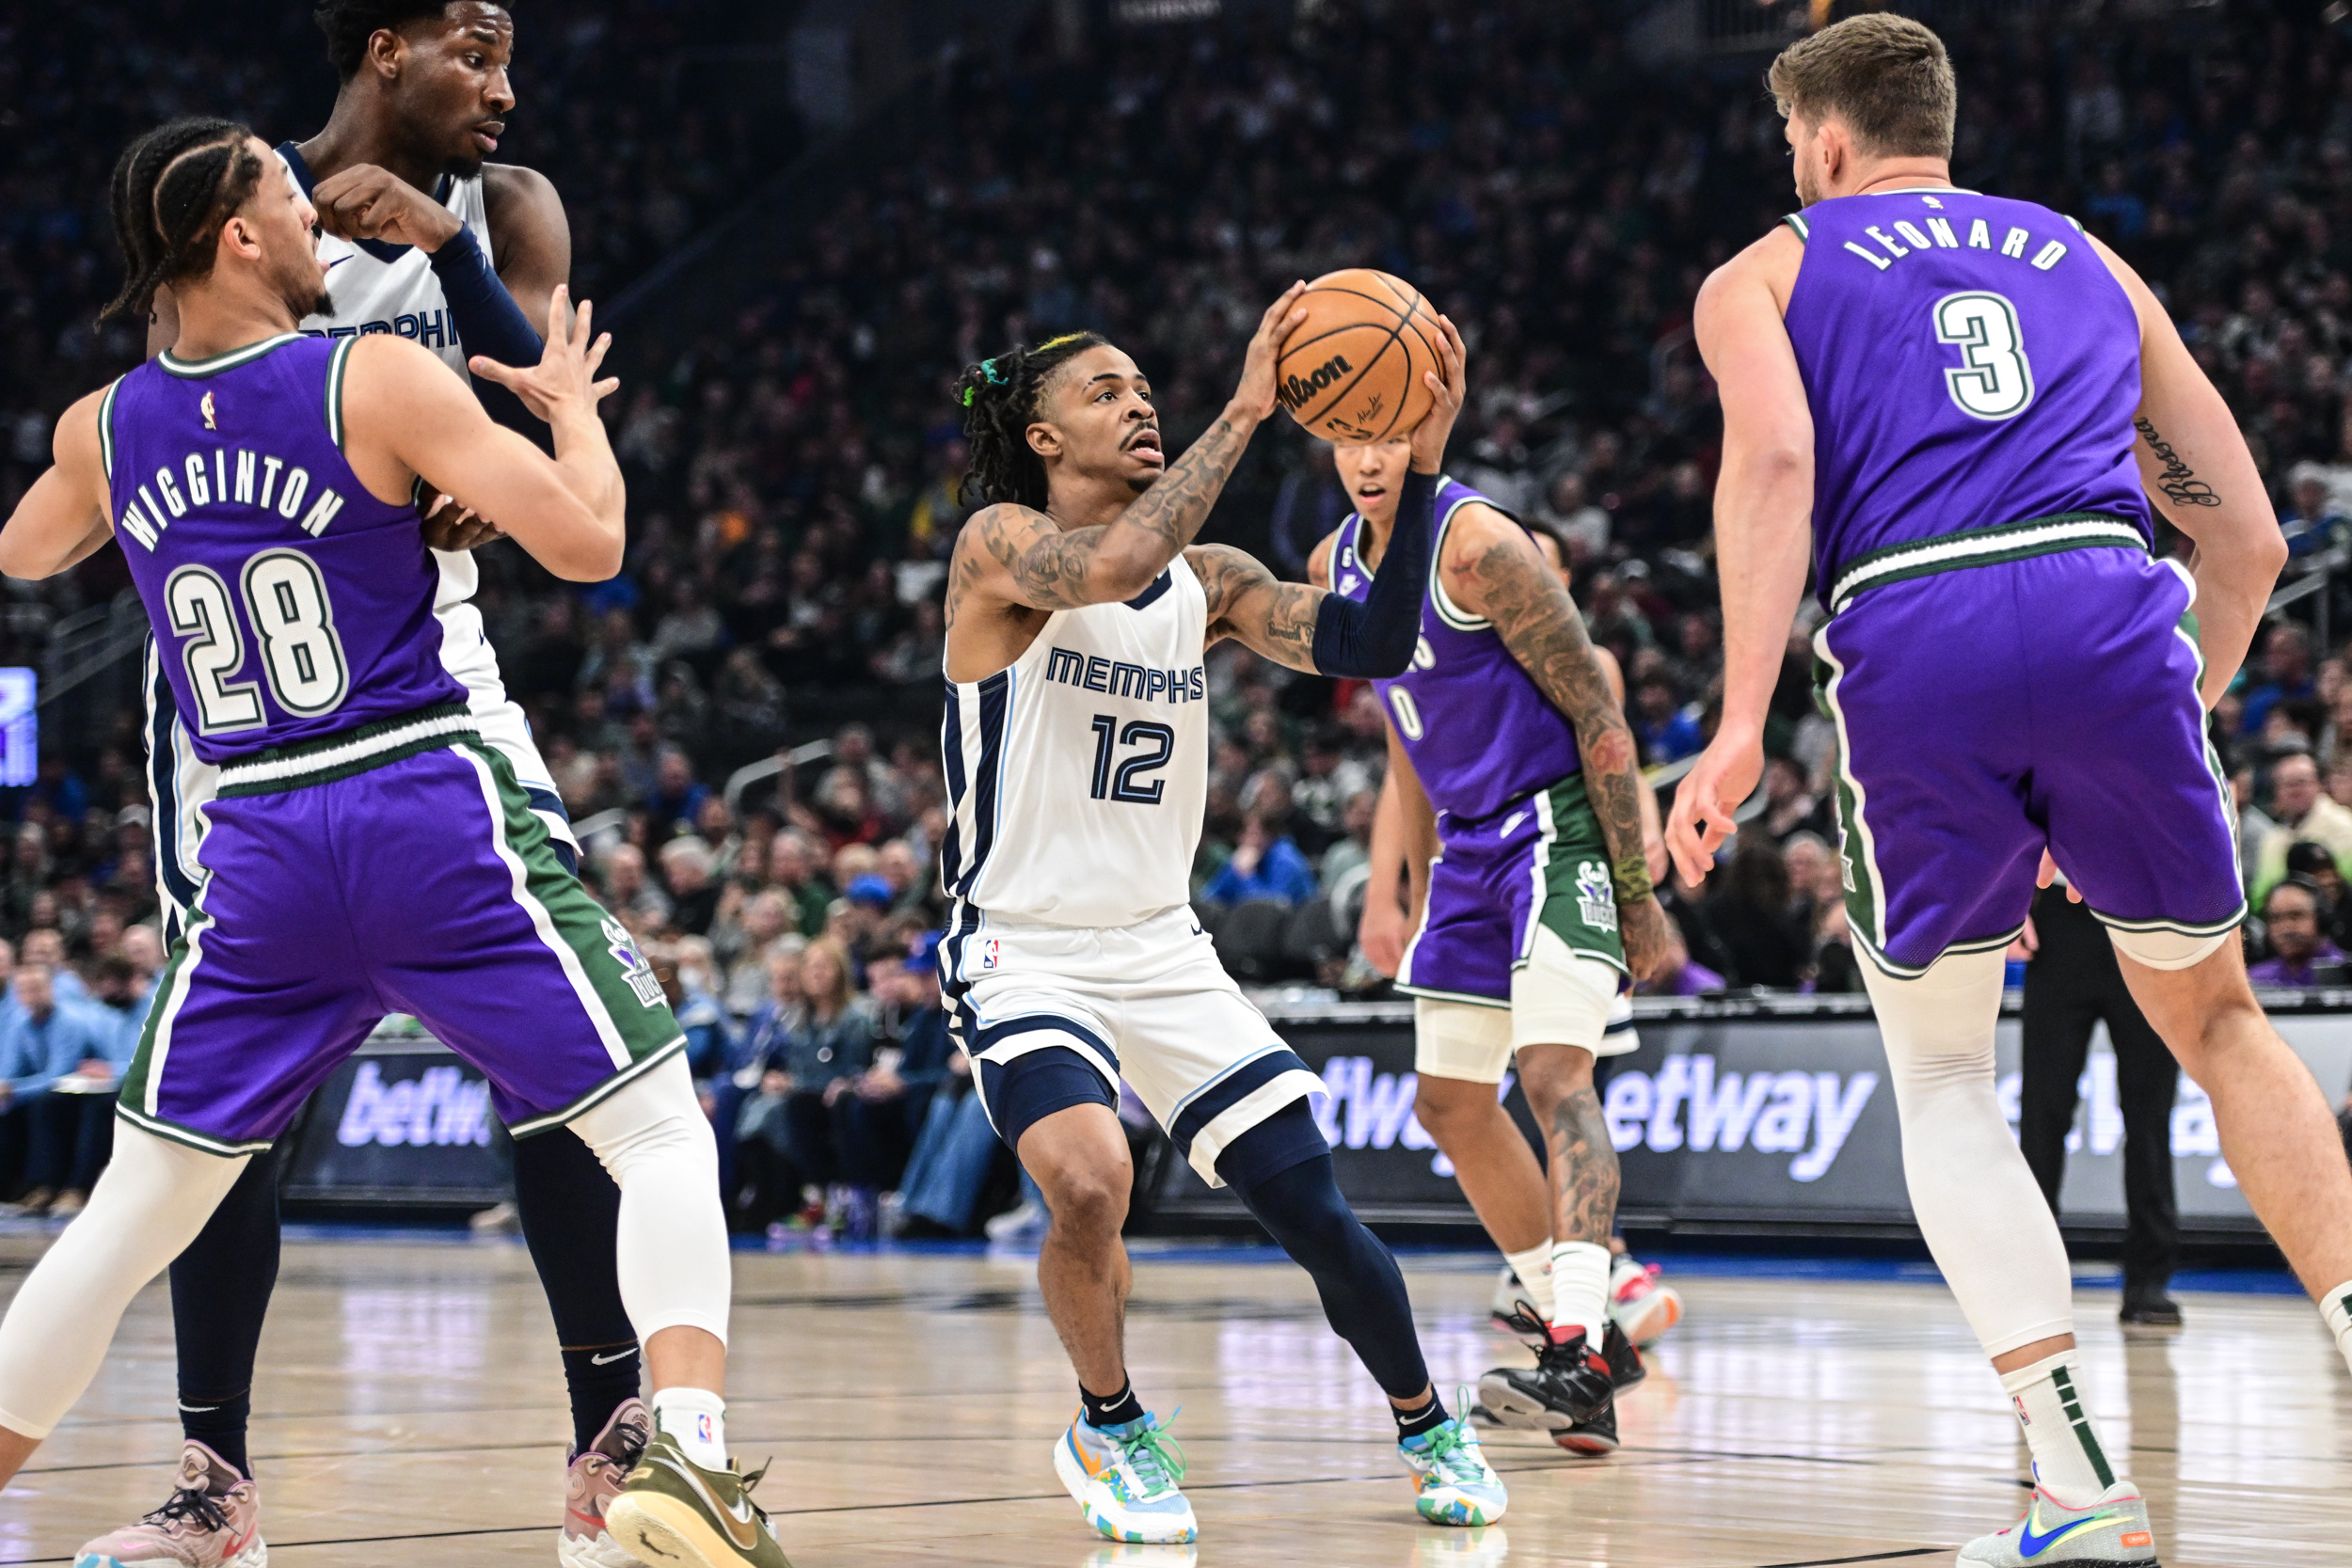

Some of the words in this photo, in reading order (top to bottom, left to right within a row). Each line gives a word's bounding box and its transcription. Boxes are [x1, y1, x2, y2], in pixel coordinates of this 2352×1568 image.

[1843, 216, 2069, 272] LEONARD
[1932, 290, 2035, 421] 3
[120, 448, 346, 553] WIGGINTON
[164, 546, 350, 737] 28
[1045, 646, 1203, 704] MEMPHS
[1388, 685, 1424, 741] 0
[1090, 714, 1175, 805] 12
[337, 1060, 492, 1148] betw
[1603, 1053, 1879, 1182] etway
